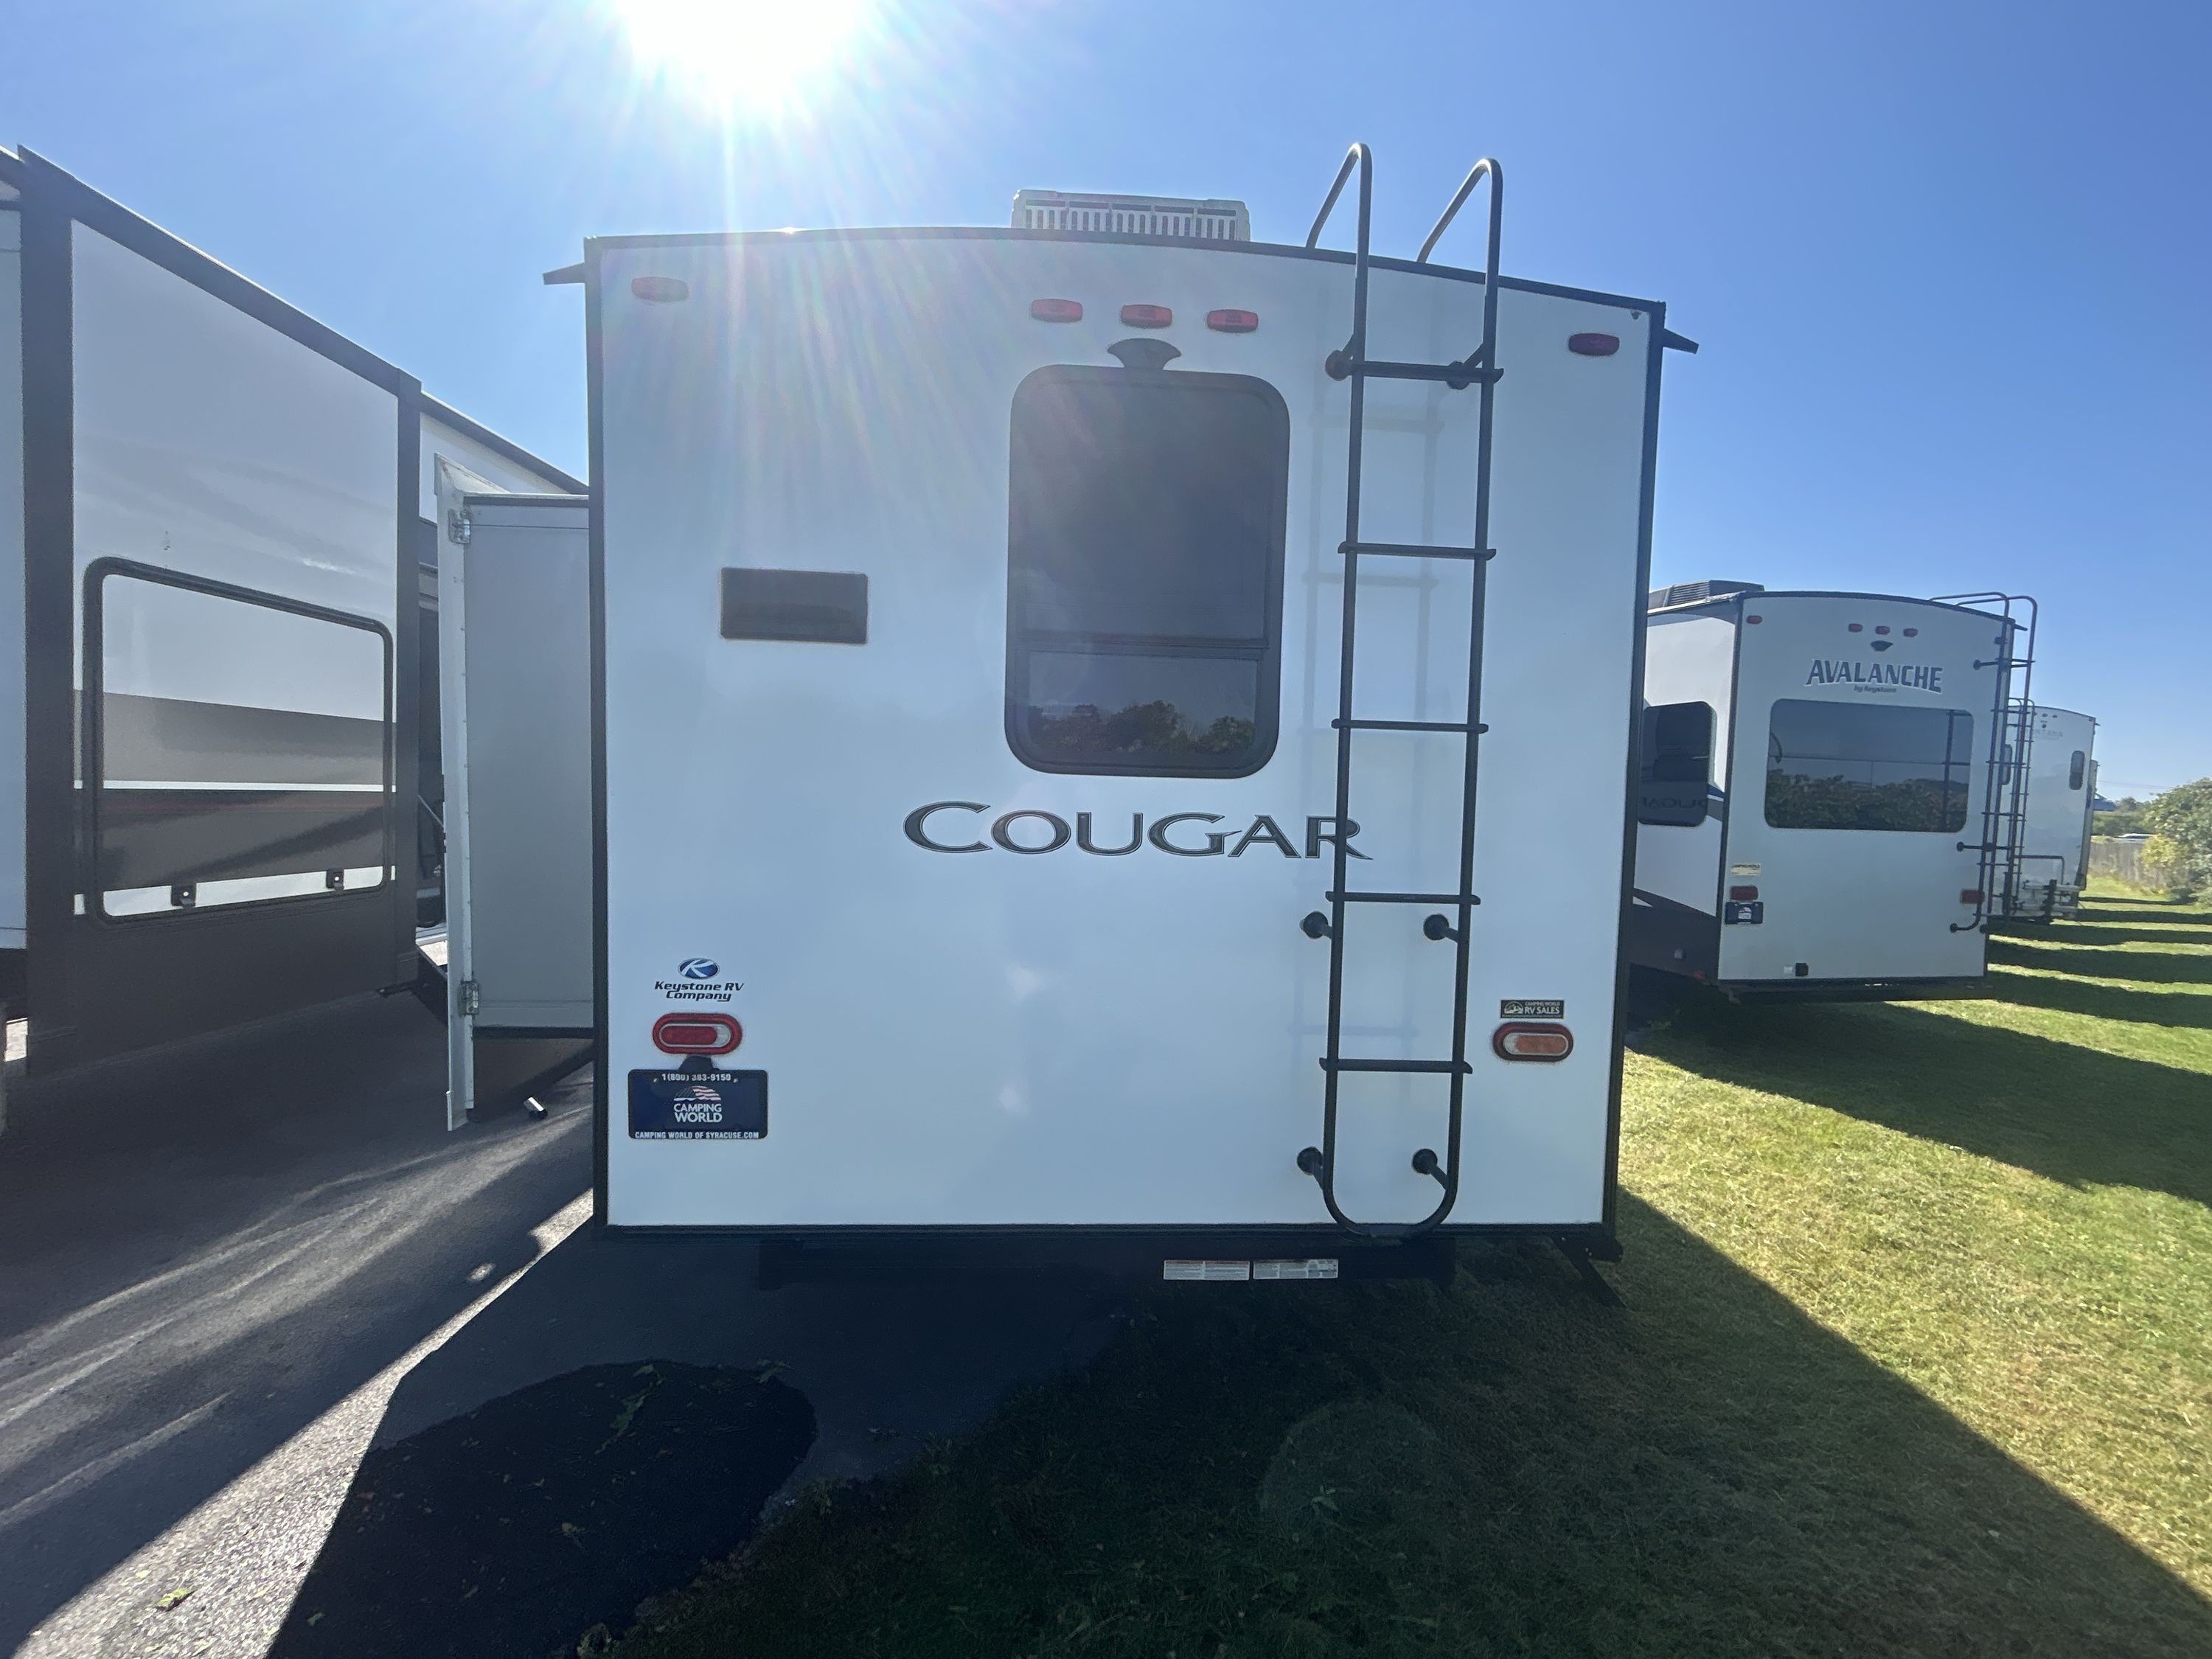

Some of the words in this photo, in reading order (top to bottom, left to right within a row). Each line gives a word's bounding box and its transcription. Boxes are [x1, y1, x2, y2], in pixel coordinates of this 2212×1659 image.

[1806, 659, 1944, 694] AVALANCHE
[903, 801, 1373, 860] COUGAR
[655, 981, 722, 992] Keystone
[724, 983, 745, 991] RV
[666, 990, 732, 1002] Company
[1537, 1006, 1560, 1015] SALES
[674, 1103, 722, 1113] CAMPING
[675, 1113, 723, 1123] WORLD
[635, 1131, 666, 1139] CAMPING
